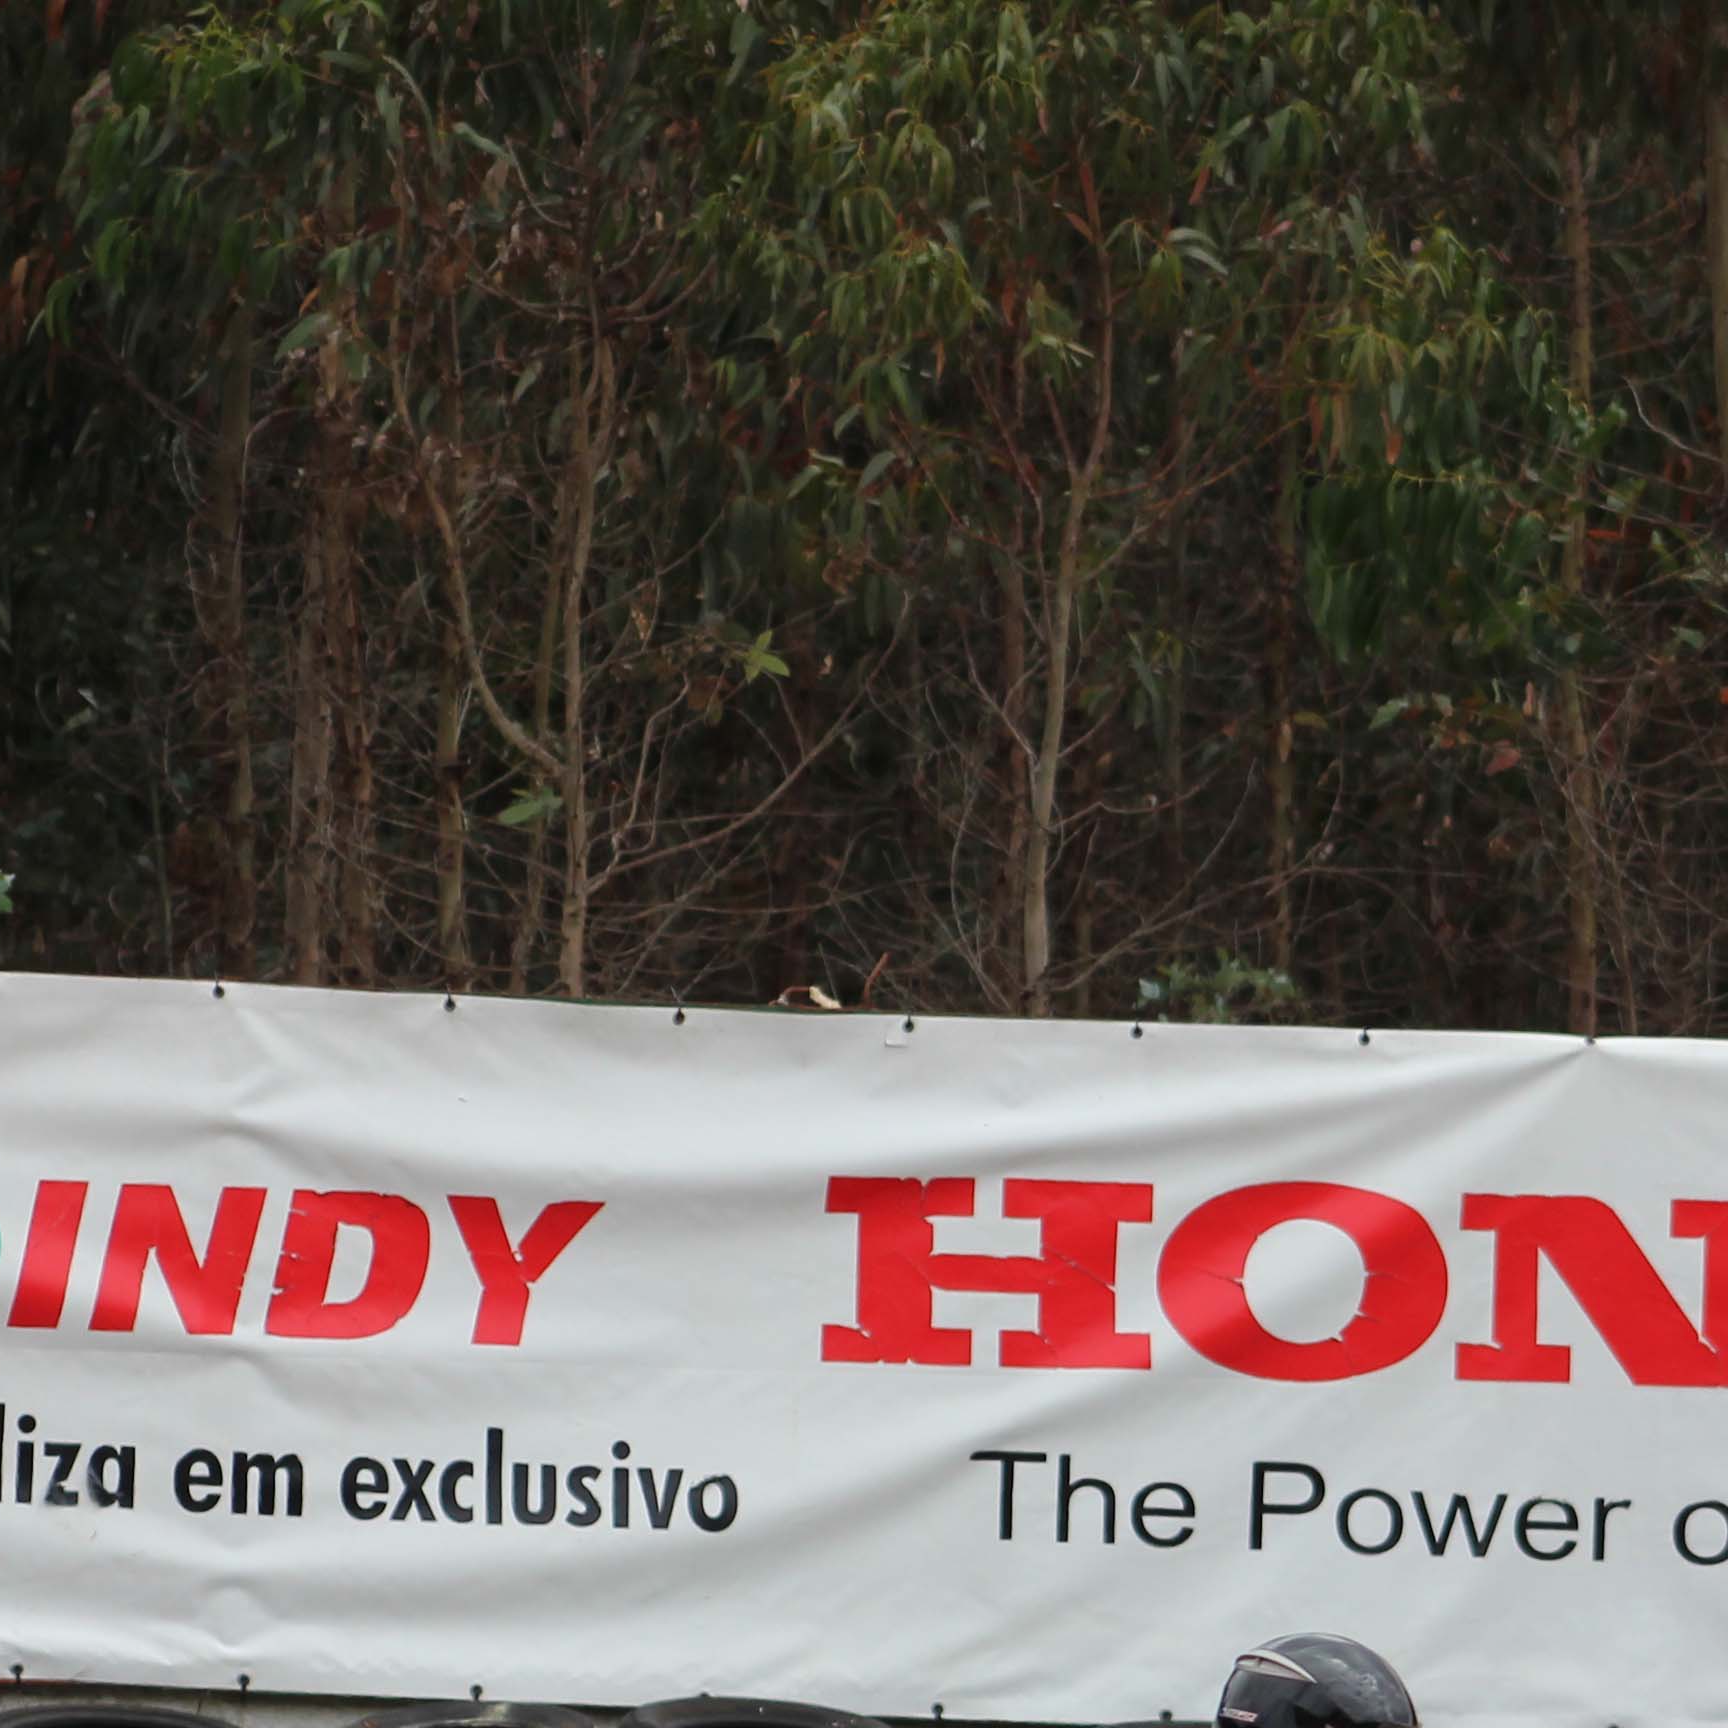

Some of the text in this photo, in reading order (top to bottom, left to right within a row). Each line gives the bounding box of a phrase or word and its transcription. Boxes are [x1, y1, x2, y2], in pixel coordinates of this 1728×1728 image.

[175, 1450, 303, 1516] em
[342, 1428, 737, 1532] exclusivo
[971, 1451, 1195, 1547] The
[1252, 1462, 1631, 1560] Power
